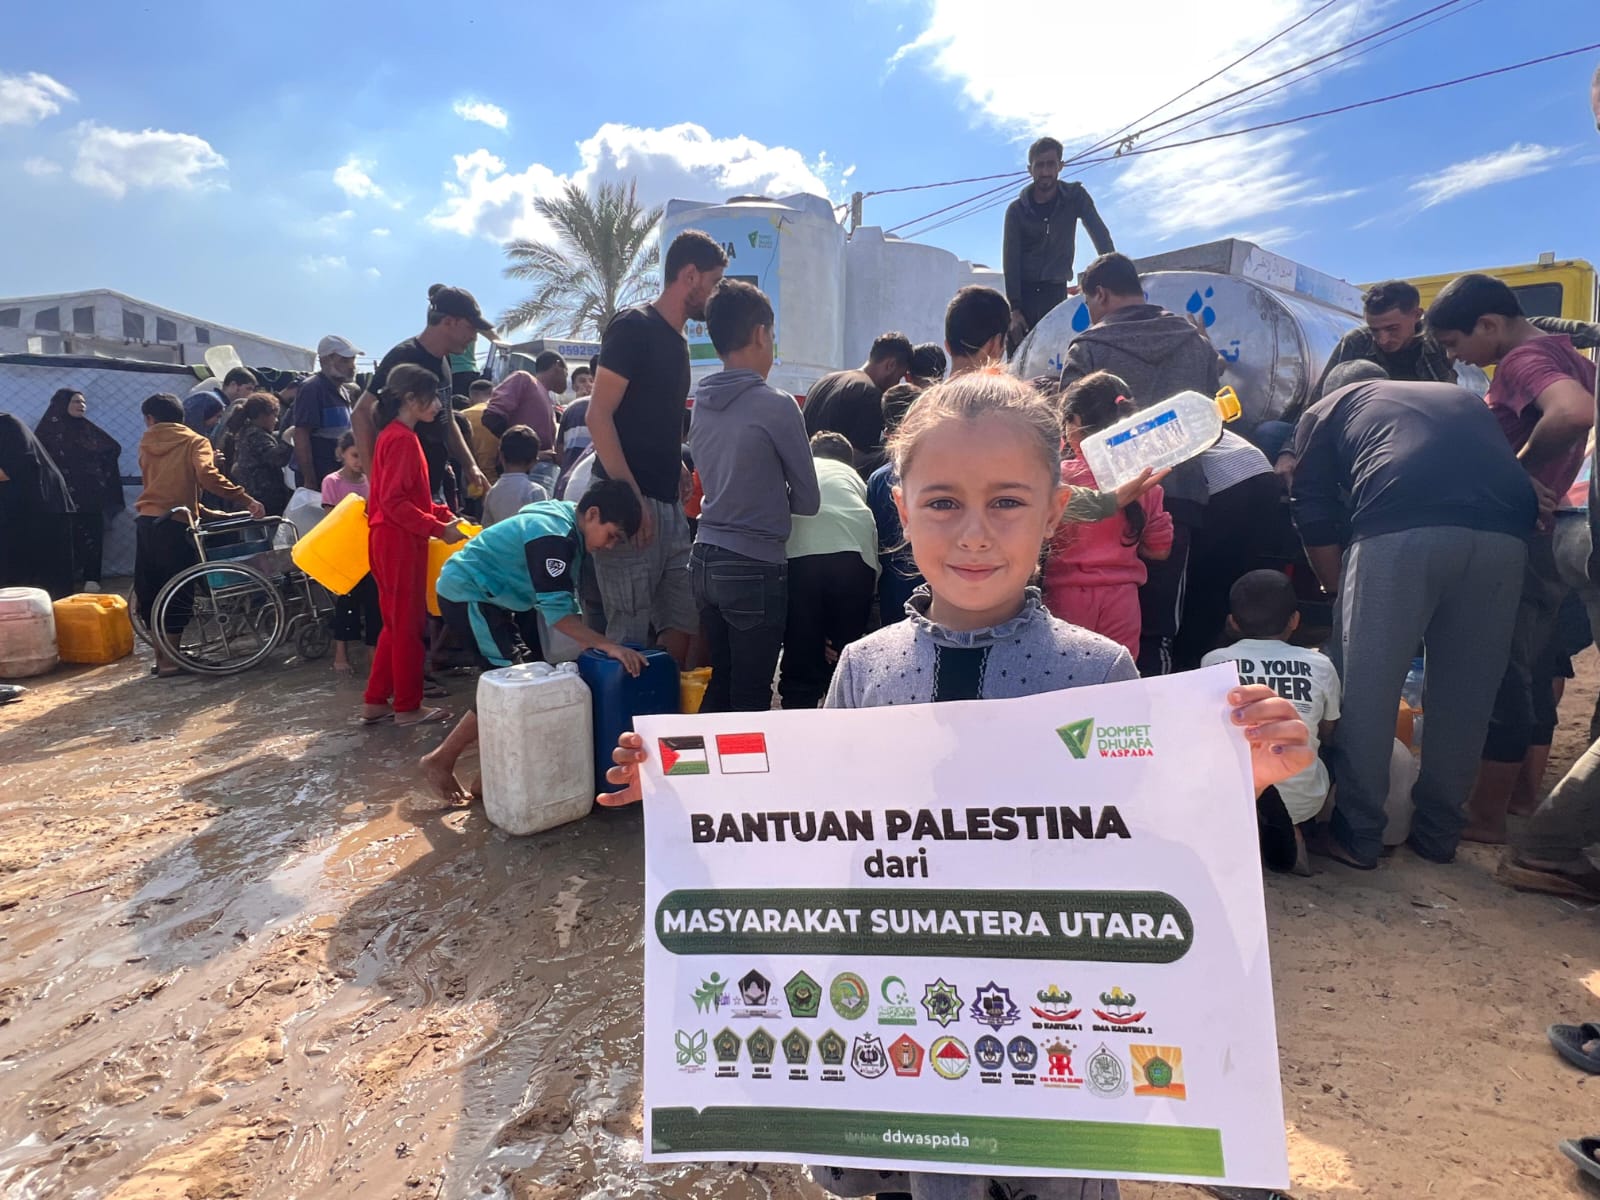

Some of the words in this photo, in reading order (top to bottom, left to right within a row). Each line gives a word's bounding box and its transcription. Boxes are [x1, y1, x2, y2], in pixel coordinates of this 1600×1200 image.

[1260, 660, 1312, 677] YOUR
[1096, 725, 1151, 738] DOMPET
[1097, 738, 1154, 750] DHUAFA
[1099, 748, 1154, 758] WASPADA
[690, 809, 875, 844] BANTUAN
[885, 805, 1132, 841] PALESTINA
[863, 847, 929, 878] dari
[661, 908, 861, 934] MASYARAKAT
[870, 908, 1051, 936] SUMATERA
[1058, 911, 1185, 941] UTARA
